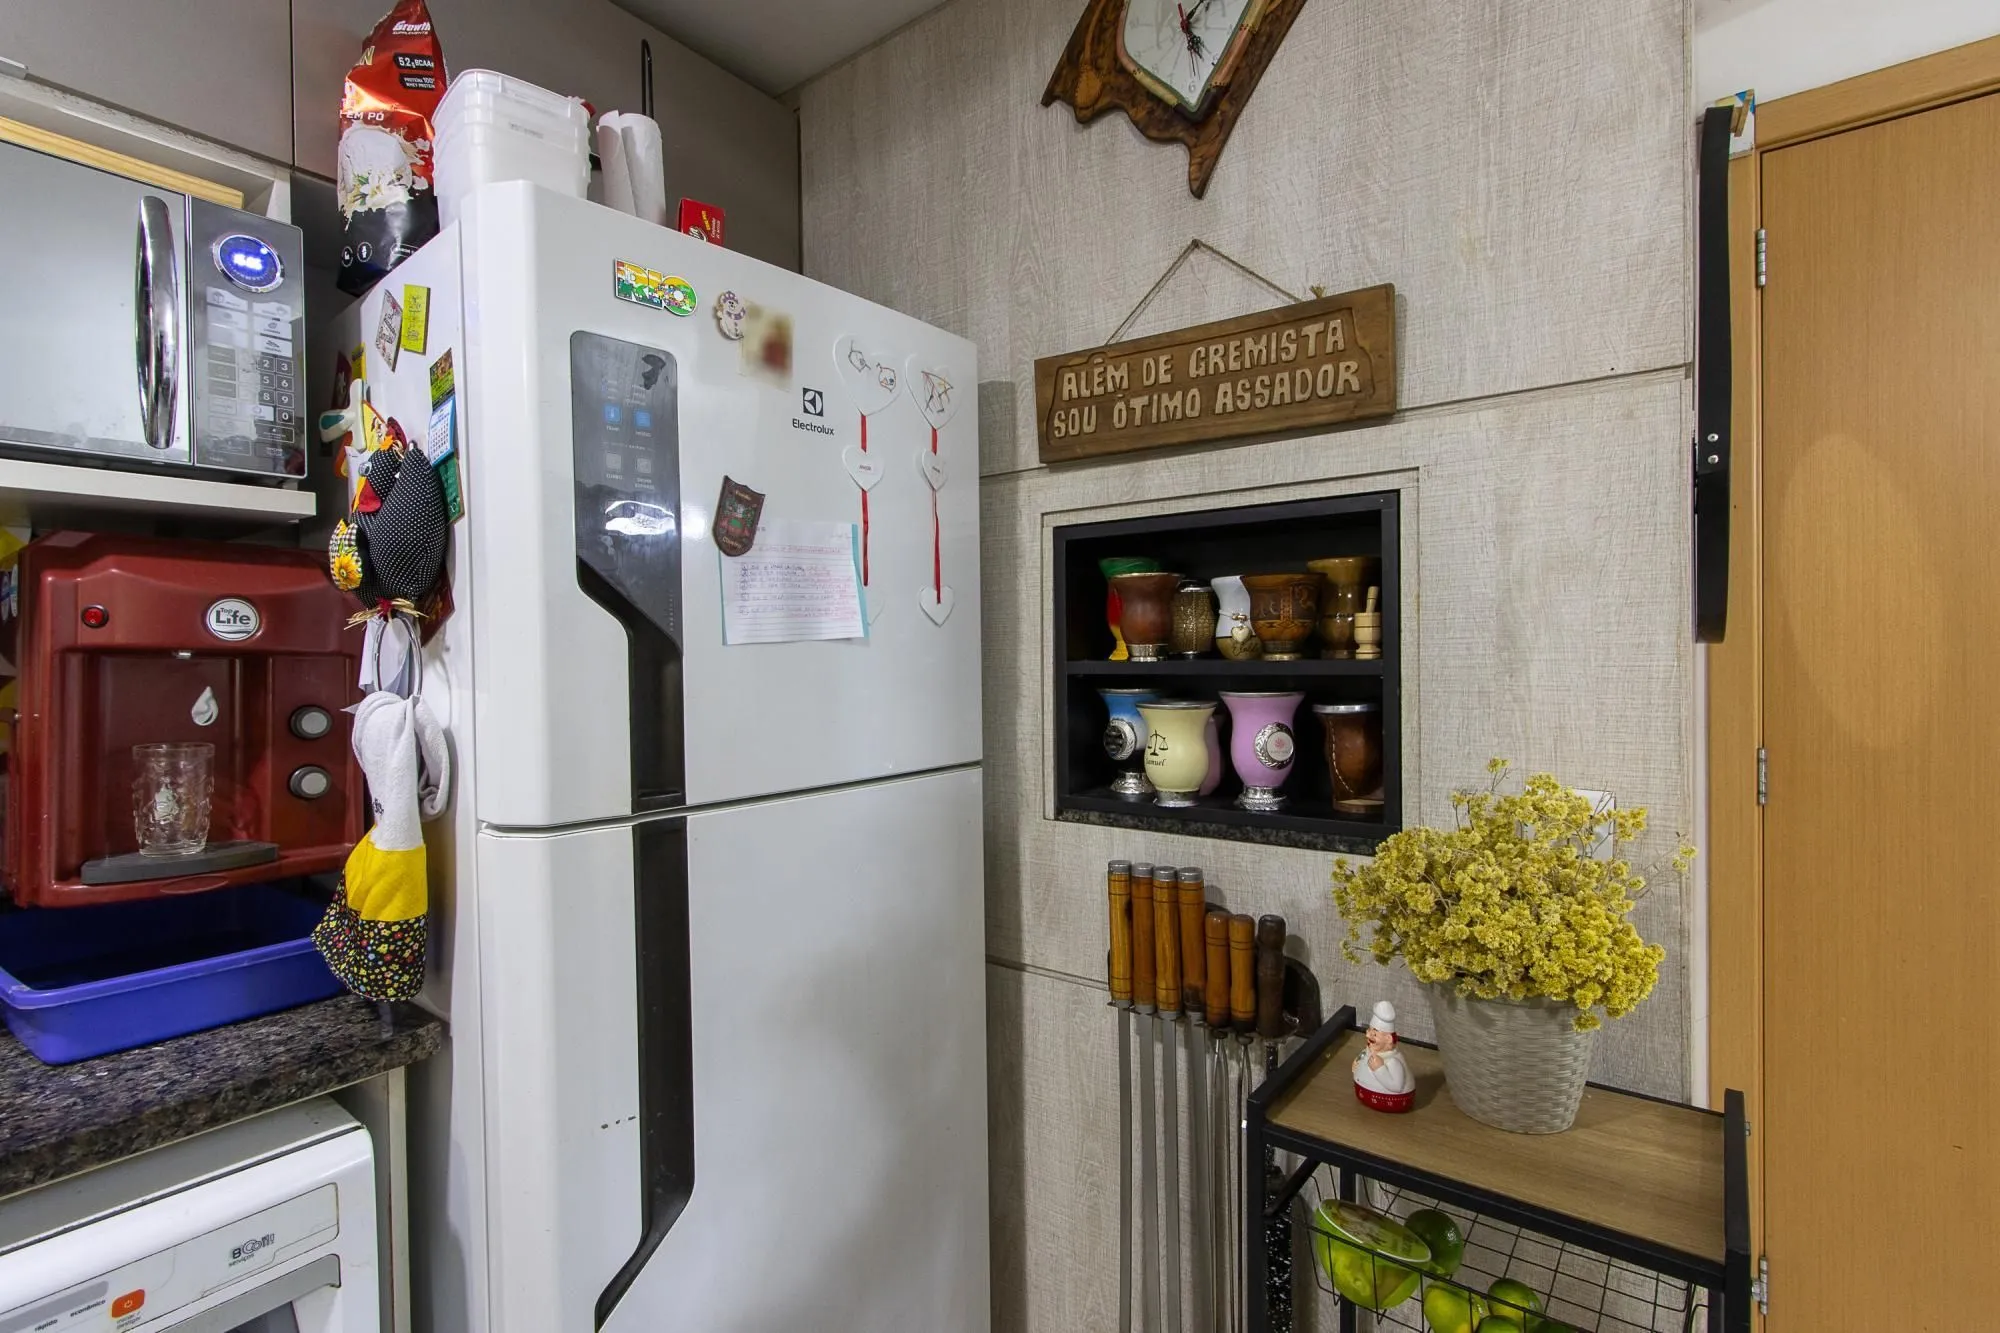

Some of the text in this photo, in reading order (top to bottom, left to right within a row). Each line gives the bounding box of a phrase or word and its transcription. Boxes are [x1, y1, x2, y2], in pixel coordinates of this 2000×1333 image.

[392, 20, 431, 31] Growth
[346, 110, 385, 121] EM PÓ
[1143, 354, 1173, 387] DE
[1188, 319, 1346, 379] GREMISTA
[264, 360, 288, 371] 2 3
[263, 376, 270, 384] 5
[263, 392, 289, 404] 8 9
[1054, 403, 1097, 438] SOU
[1215, 361, 1361, 415] ASSADOR
[282, 412, 289, 420] 0
[792, 418, 835, 436] Electrolux
[215, 609, 251, 625] Life
[70, 1299, 106, 1318] econômico
